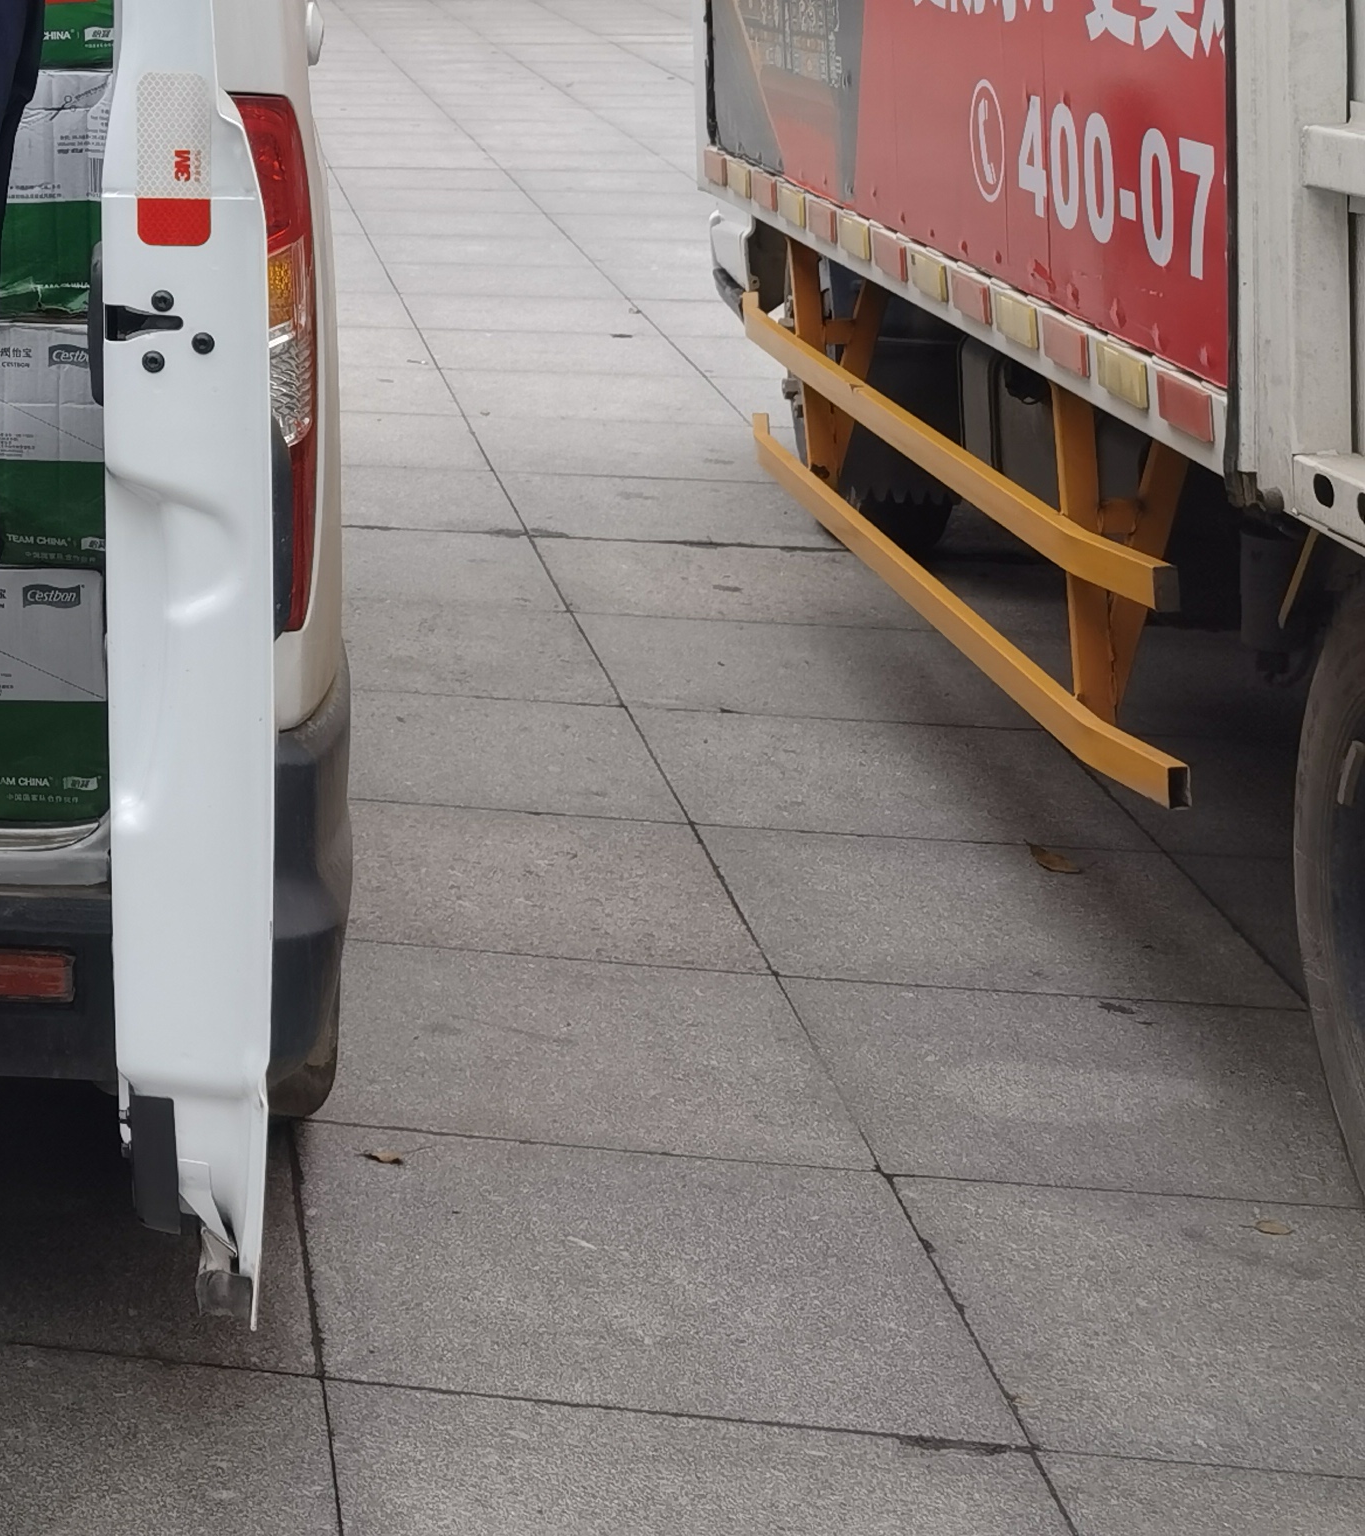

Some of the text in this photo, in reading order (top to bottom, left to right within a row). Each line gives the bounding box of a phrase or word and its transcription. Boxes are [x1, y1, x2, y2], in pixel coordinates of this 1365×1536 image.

[175, 150, 191, 182] 3M
[6, 533, 68, 547] TEAM CHINA
[18, 777, 50, 787] CHINA
